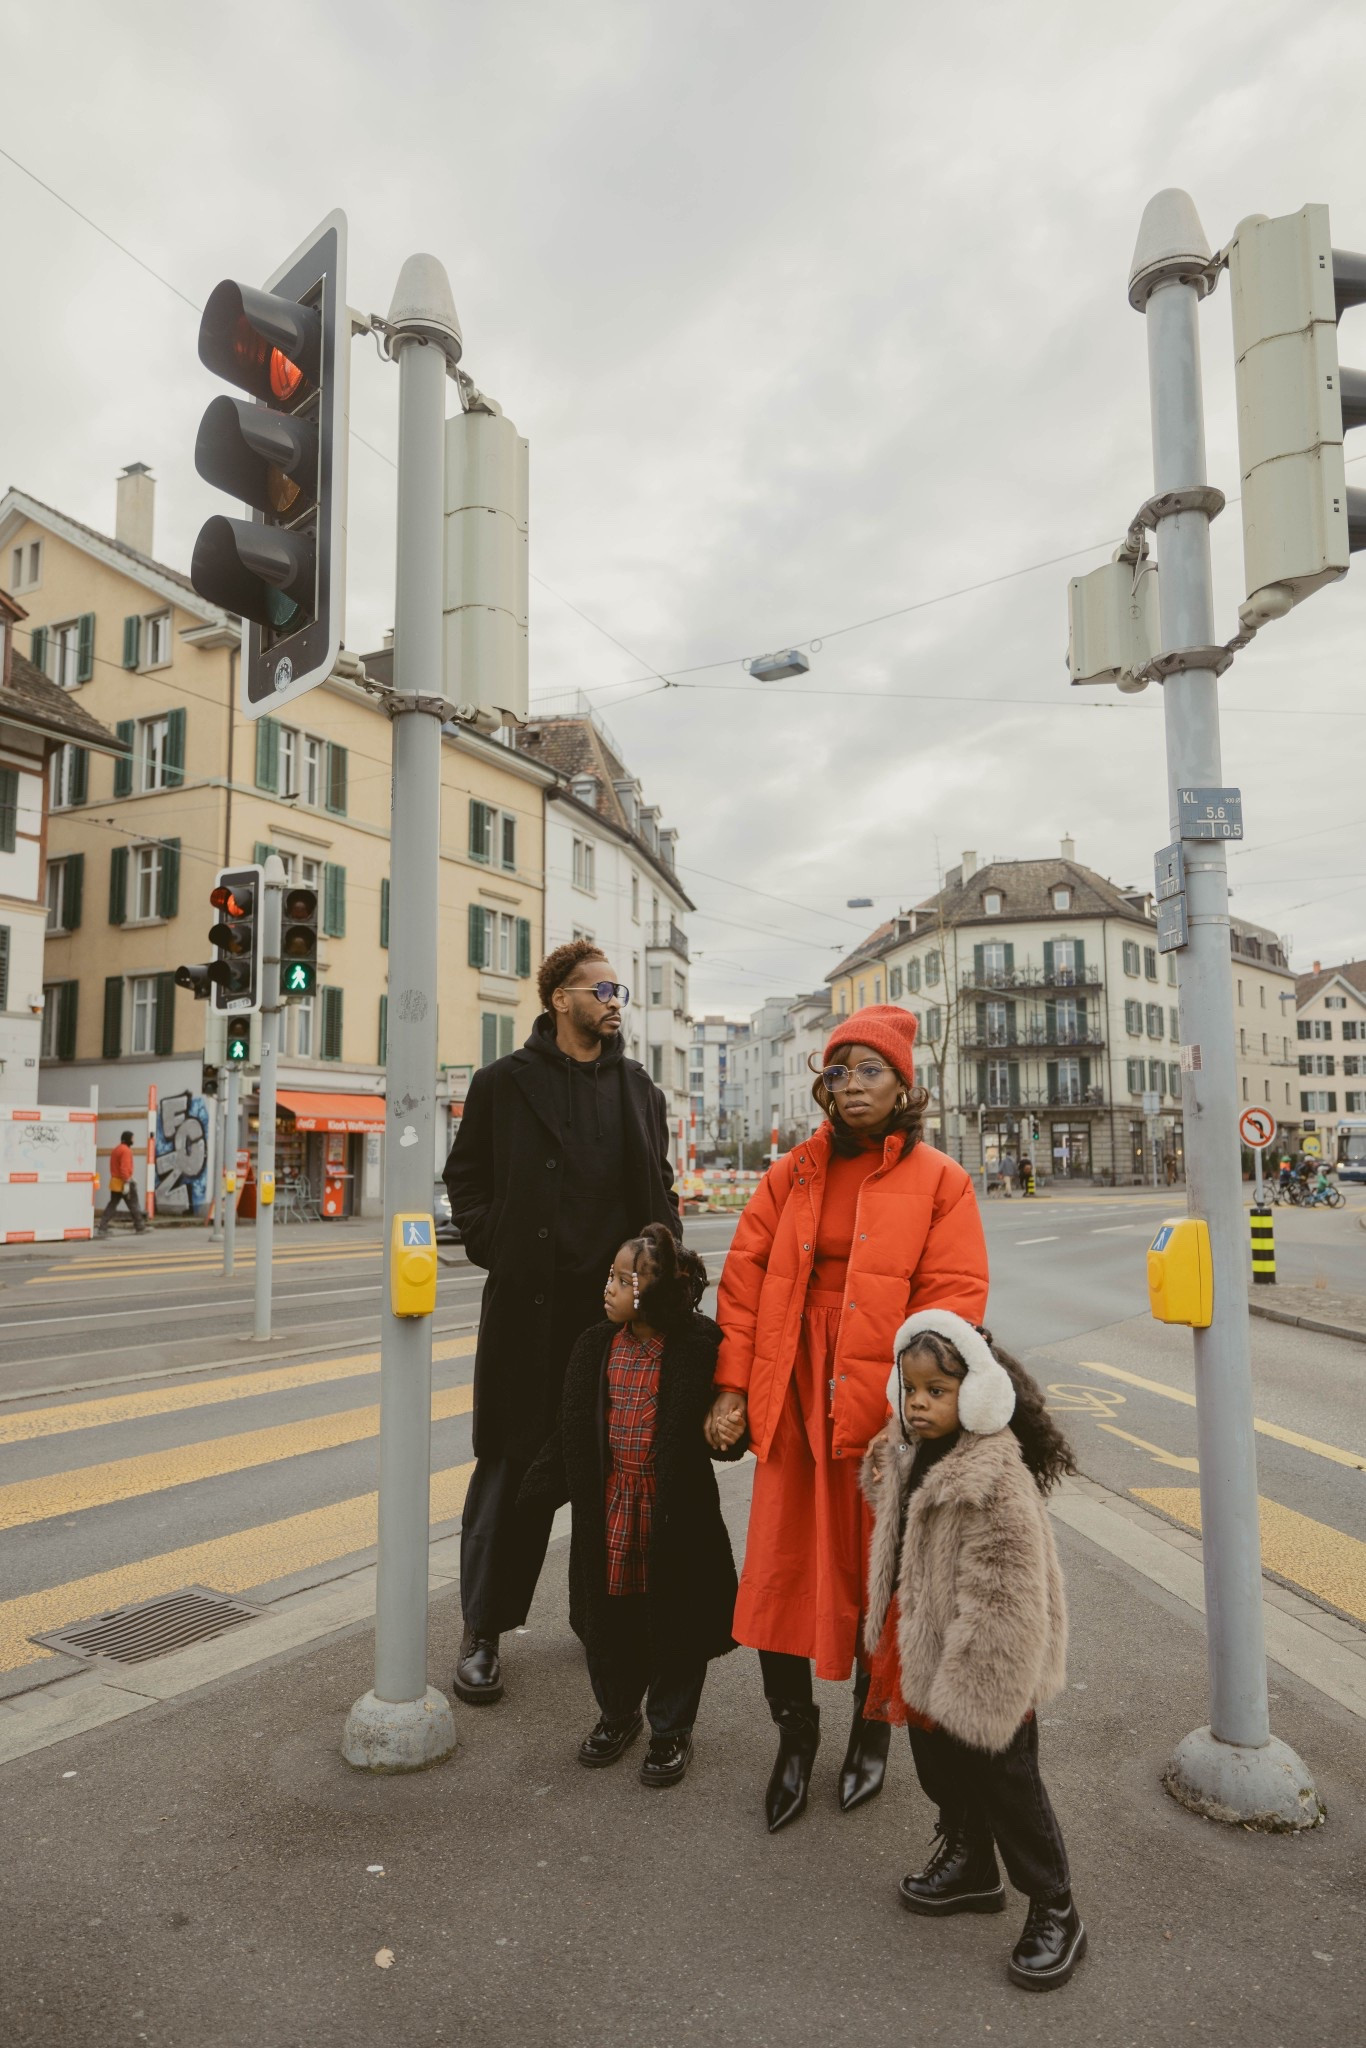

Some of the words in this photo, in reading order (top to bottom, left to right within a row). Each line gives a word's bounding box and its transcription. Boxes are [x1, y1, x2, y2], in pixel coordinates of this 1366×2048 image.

[1182, 791, 1198, 804] KL
[1206, 806, 1226, 819] 5,6
[1222, 823, 1242, 837] 0,5
[1168, 863, 1173, 878] E
[327, 1119, 346, 1131] Kiosk
